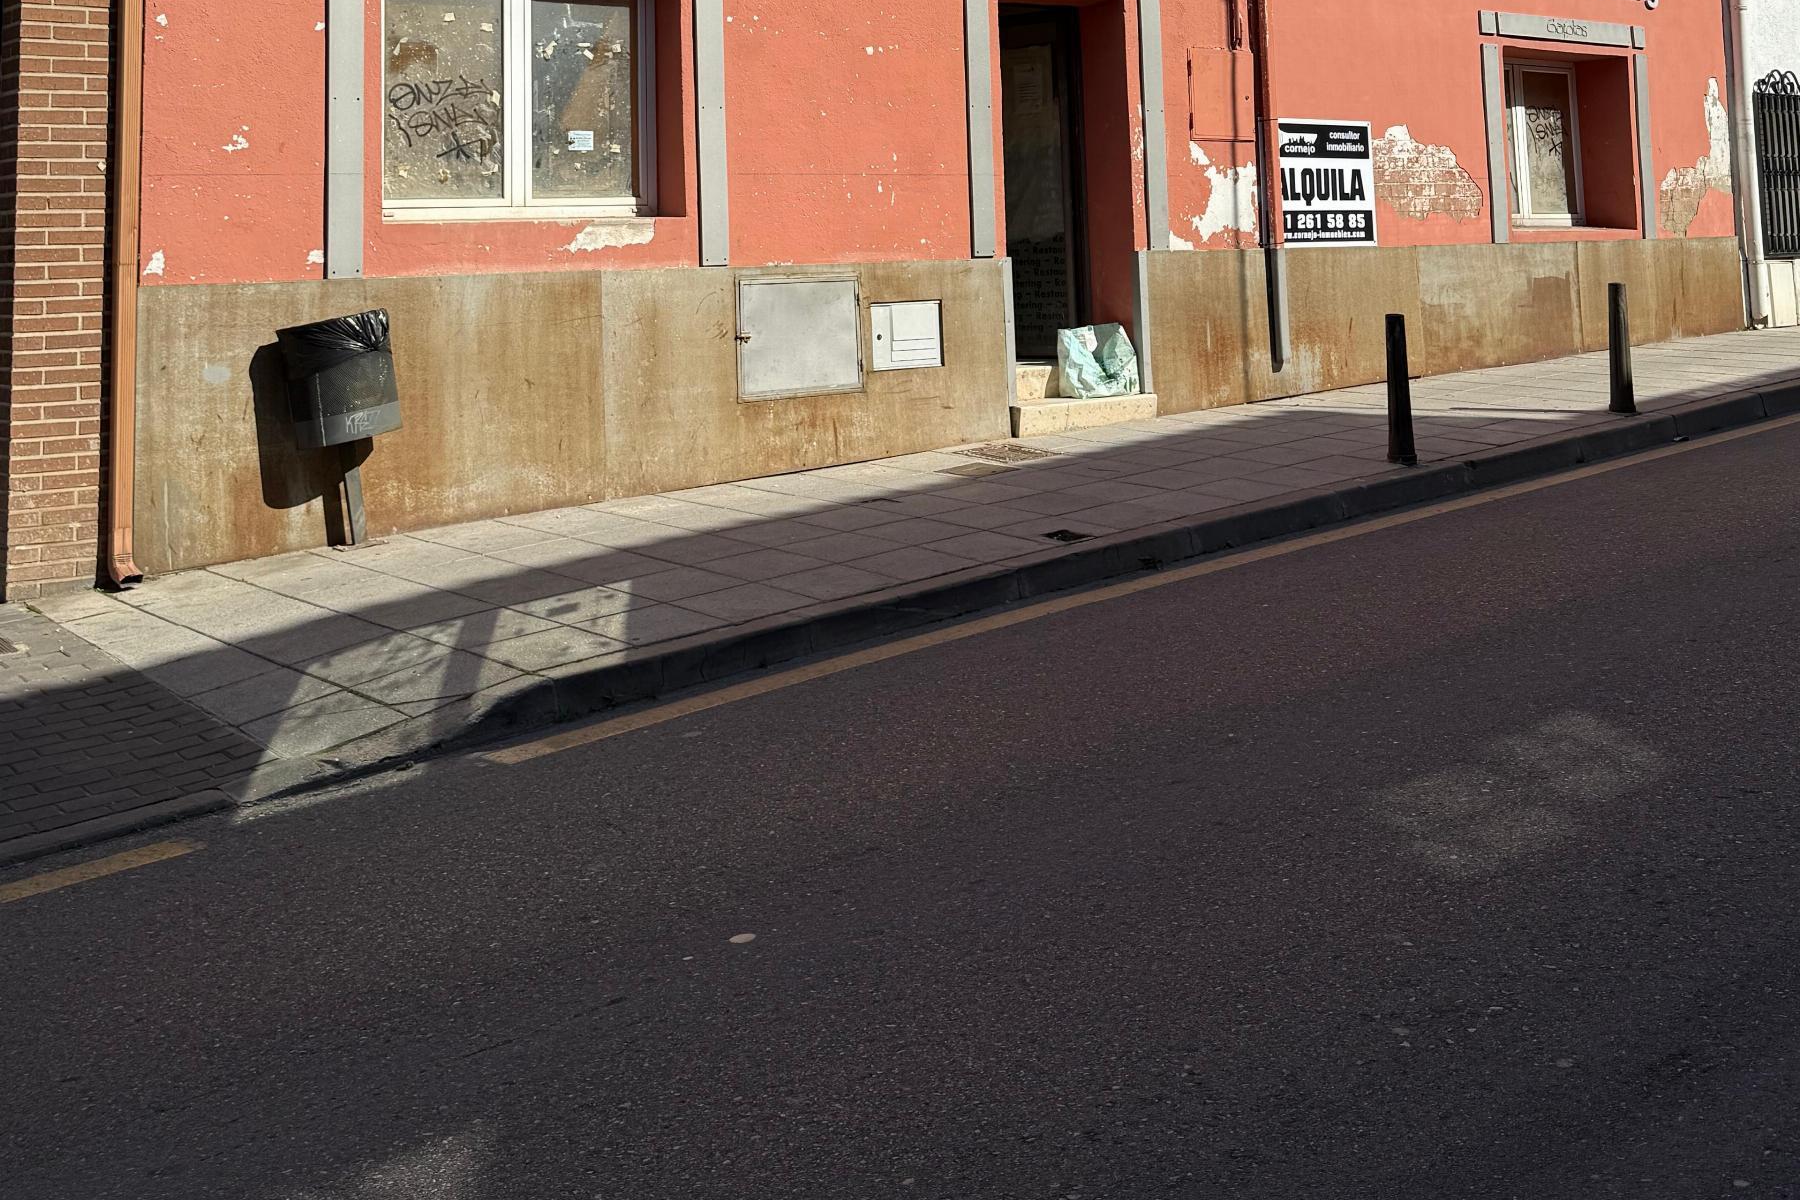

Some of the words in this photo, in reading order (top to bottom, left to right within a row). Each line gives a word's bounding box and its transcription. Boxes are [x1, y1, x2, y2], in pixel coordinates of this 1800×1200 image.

[1329, 130, 1360, 140] consultor
[1284, 142, 1316, 155] cornejo
[1326, 142, 1364, 152] inmobiliario
[1297, 213, 1321, 229] 261
[1327, 213, 1344, 229] 58
[1348, 213, 1366, 229] 85
